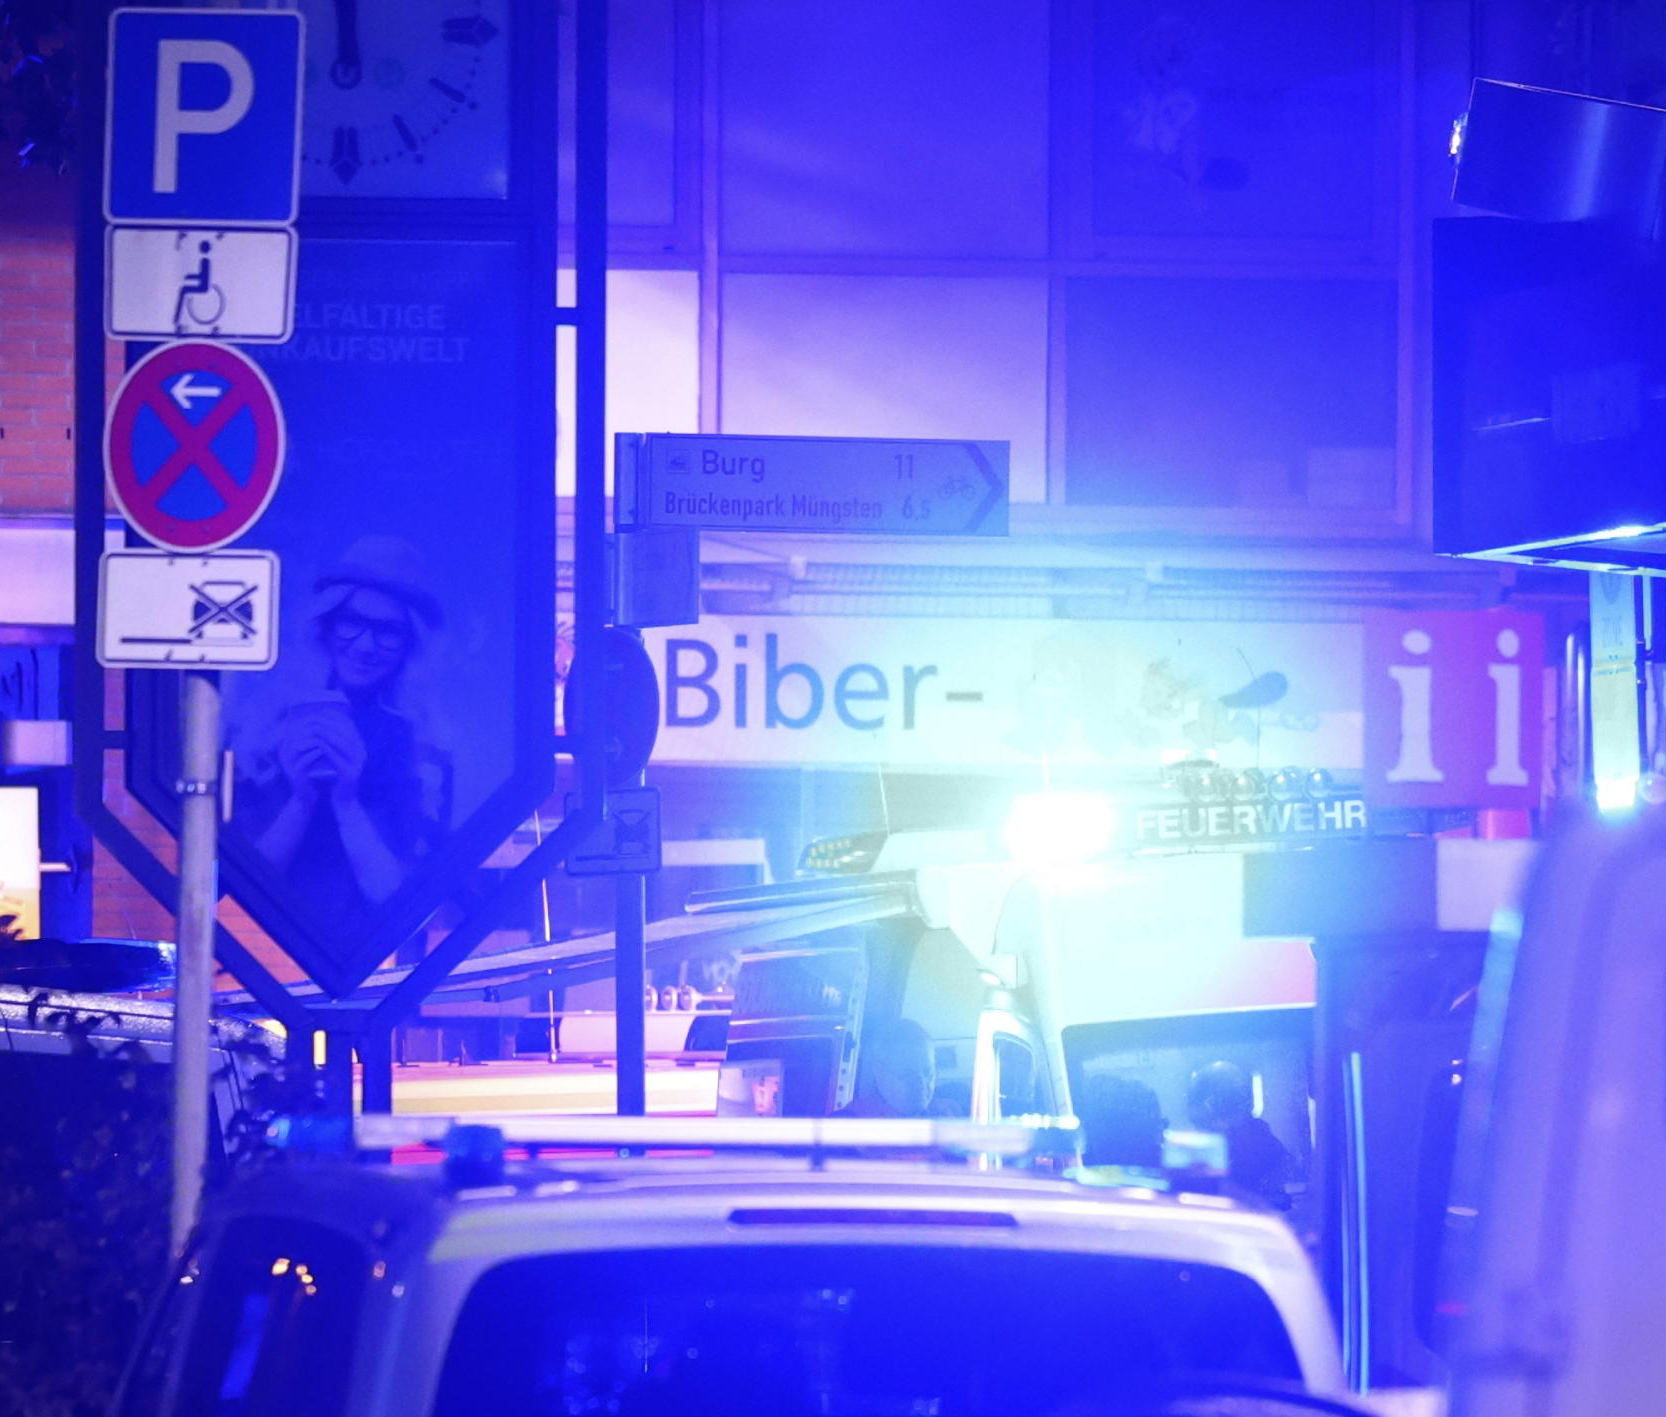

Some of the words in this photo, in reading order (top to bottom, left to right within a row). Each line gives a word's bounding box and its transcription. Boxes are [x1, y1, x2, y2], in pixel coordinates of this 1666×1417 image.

[151, 38, 256, 194] P
[296, 299, 446, 330] ELFÄLTIGE
[258, 334, 471, 364] NKAUFSWELT
[700, 448, 766, 484] Burg
[894, 453, 914, 480] 11
[664, 491, 785, 522] Brückenpark
[791, 494, 883, 523] Müngsten
[664, 632, 985, 731] Biber-
[1135, 799, 1367, 841] FEUERWEHR
